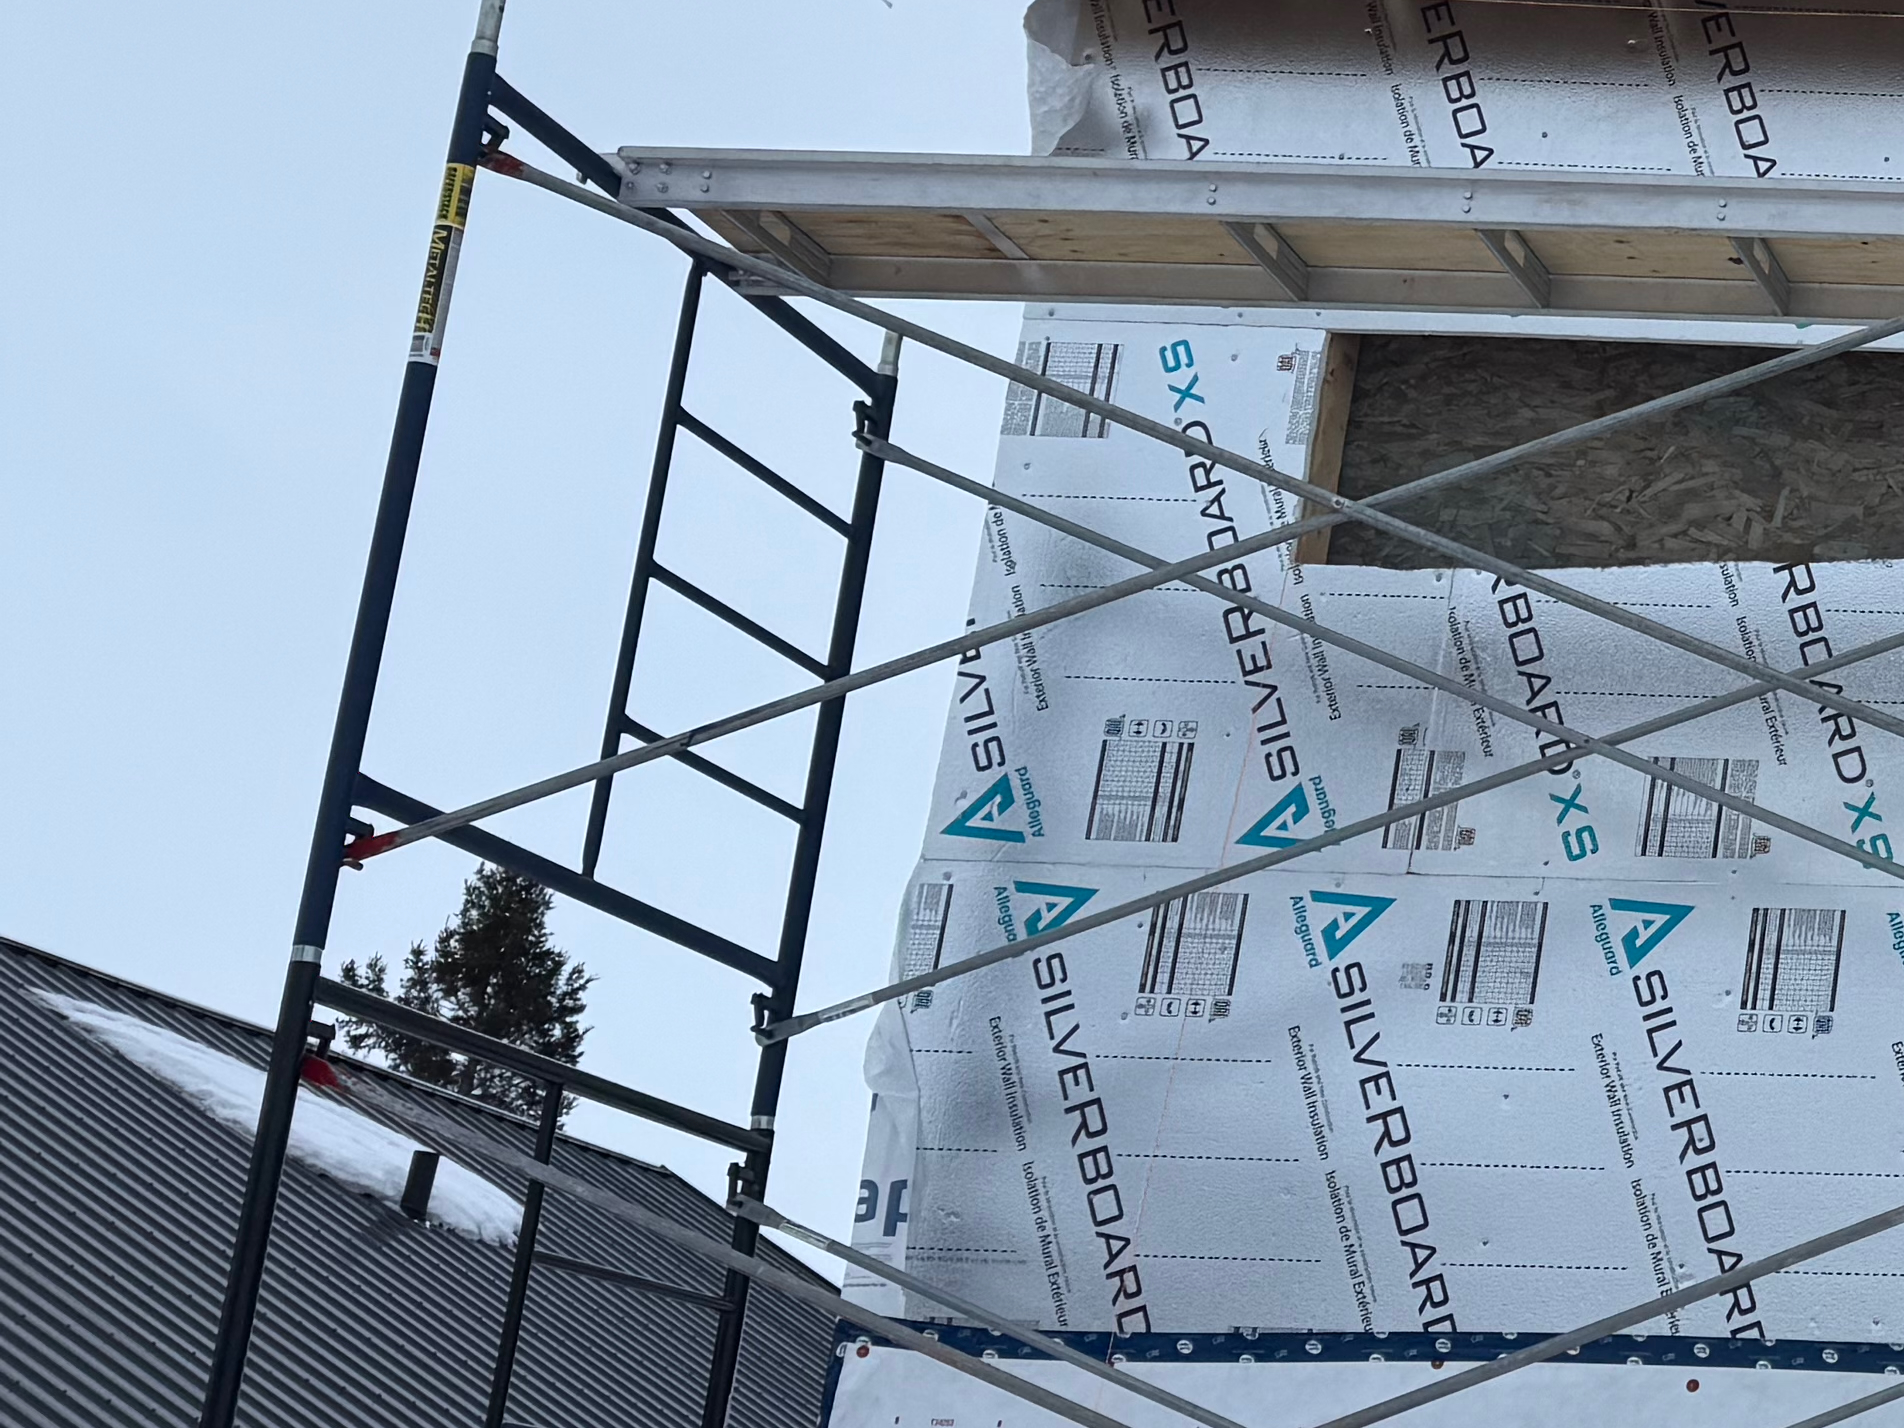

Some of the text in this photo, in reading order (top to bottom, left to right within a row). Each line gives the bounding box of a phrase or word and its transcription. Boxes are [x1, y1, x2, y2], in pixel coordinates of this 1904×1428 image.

[416, 228, 448, 333] METALTECH
[1158, 337, 1207, 410] XS
[1016, 766, 1045, 838] Alleguard
[1548, 781, 1600, 863] XS
[1843, 791, 1895, 869] XS
[1289, 895, 1321, 970] Alleguard
[1590, 903, 1621, 978] Alleguard
[989, 1016, 1028, 1152] Exterior Wall Insulation
[1022, 1161, 1044, 1219] Isolation
[1039, 1232, 1059, 1275] Mural
